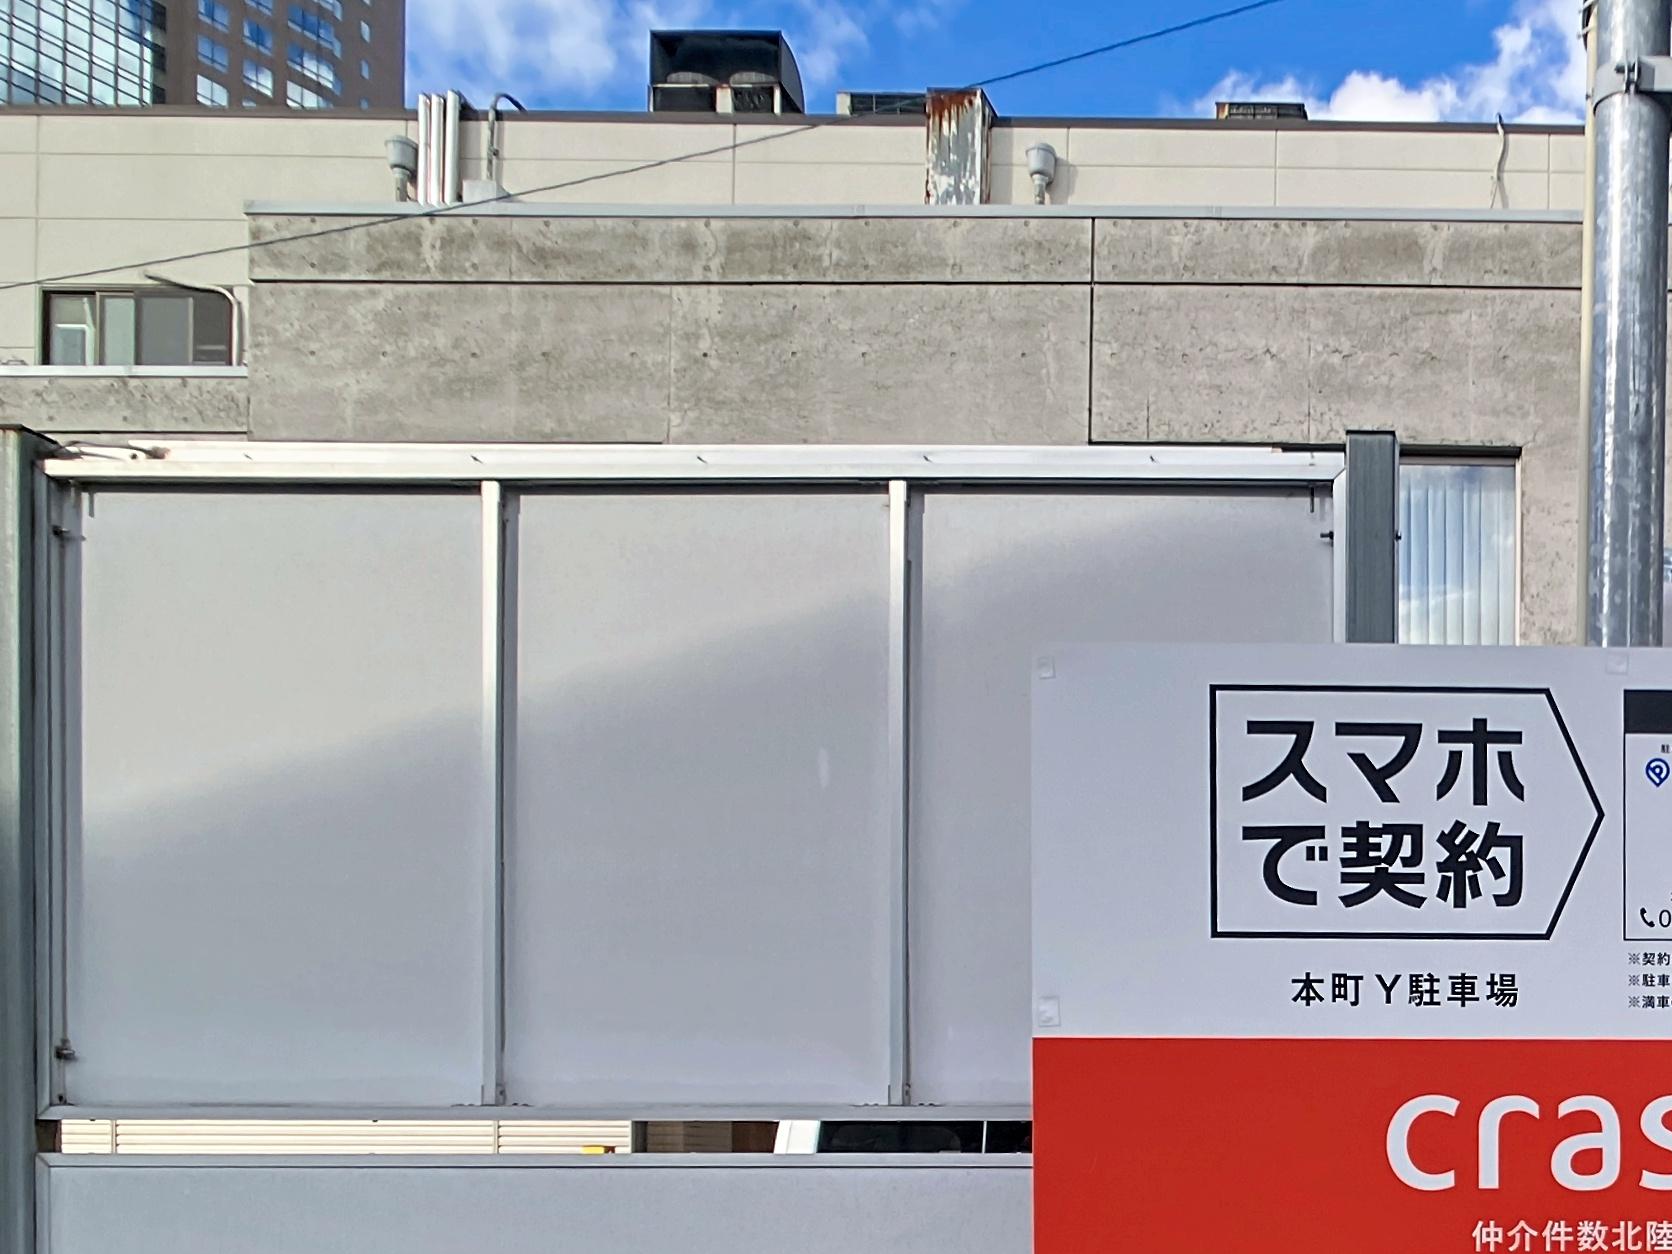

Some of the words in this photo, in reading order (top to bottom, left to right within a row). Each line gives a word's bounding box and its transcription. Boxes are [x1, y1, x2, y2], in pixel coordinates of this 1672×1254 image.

[1242, 718, 1524, 806] スマホ
[1242, 819, 1523, 909] で契約
